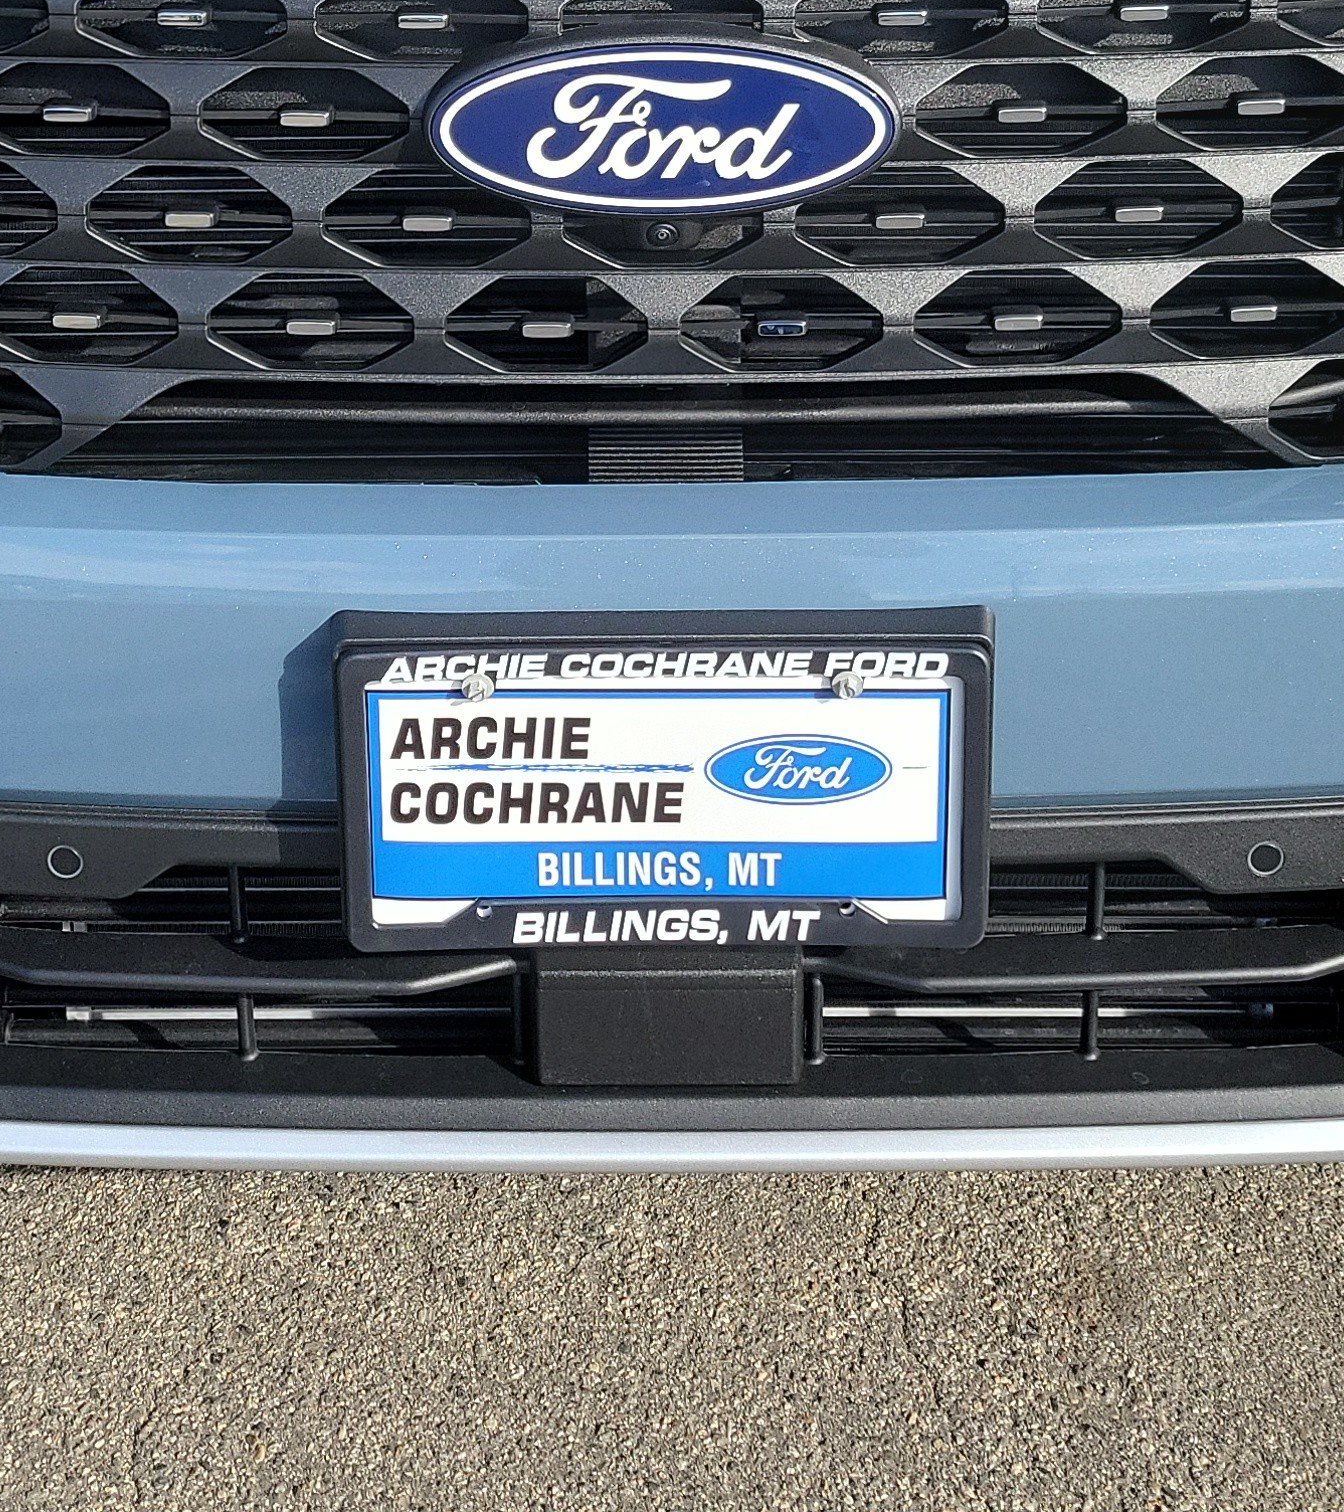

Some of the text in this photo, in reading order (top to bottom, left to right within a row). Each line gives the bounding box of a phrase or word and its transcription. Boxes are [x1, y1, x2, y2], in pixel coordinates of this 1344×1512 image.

[525, 73, 801, 180] Ford
[380, 650, 950, 683] ARCHIE COCHRANE FORD
[389, 716, 592, 760] ARCHIE
[743, 744, 853, 789] Ford
[389, 781, 684, 825] COCHRANE
[537, 850, 783, 892] BILLINGS, MT
[512, 908, 821, 945] BILLINGS, MT
